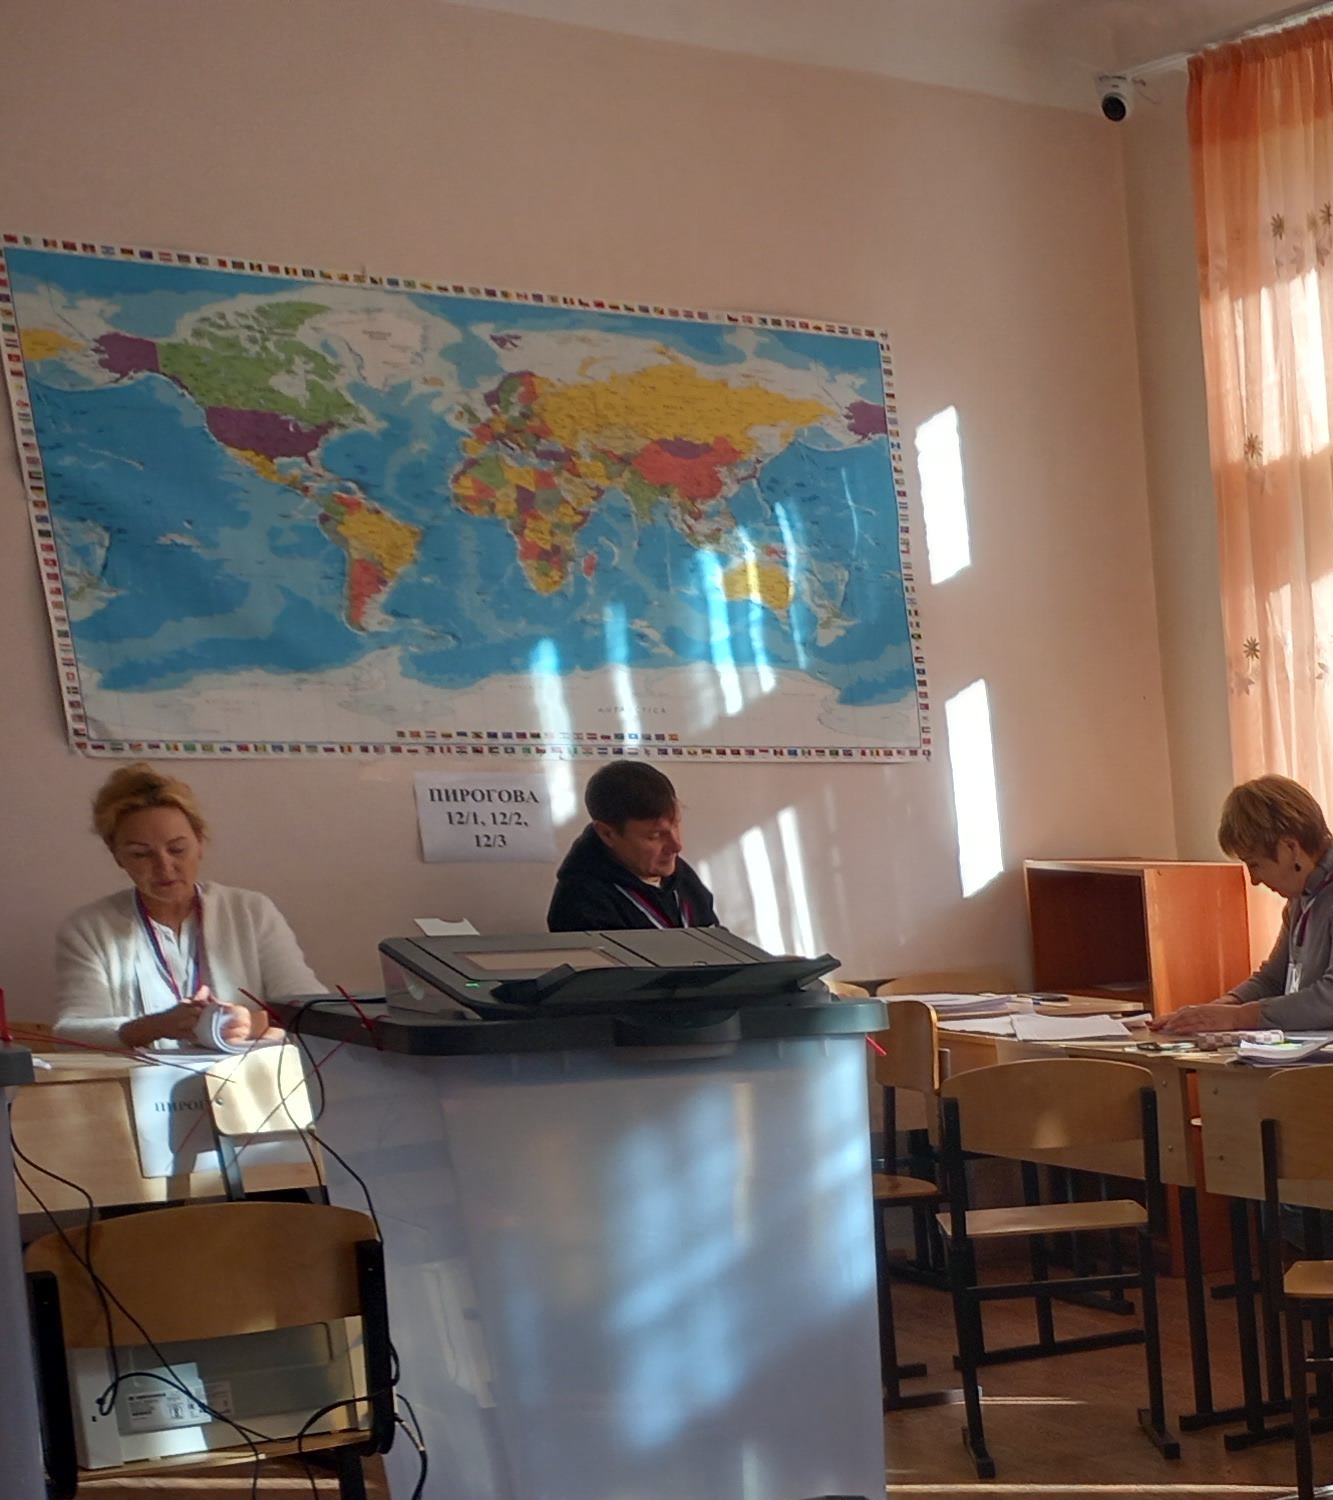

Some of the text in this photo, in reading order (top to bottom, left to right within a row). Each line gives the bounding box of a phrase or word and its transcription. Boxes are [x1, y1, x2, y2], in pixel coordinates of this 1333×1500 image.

[598, 706, 667, 714] ANTACTICA
[429, 788, 540, 803] ПИРОГОВА
[447, 811, 529, 827] 12/1, 12/2,
[474, 834, 507, 848] 12/3
